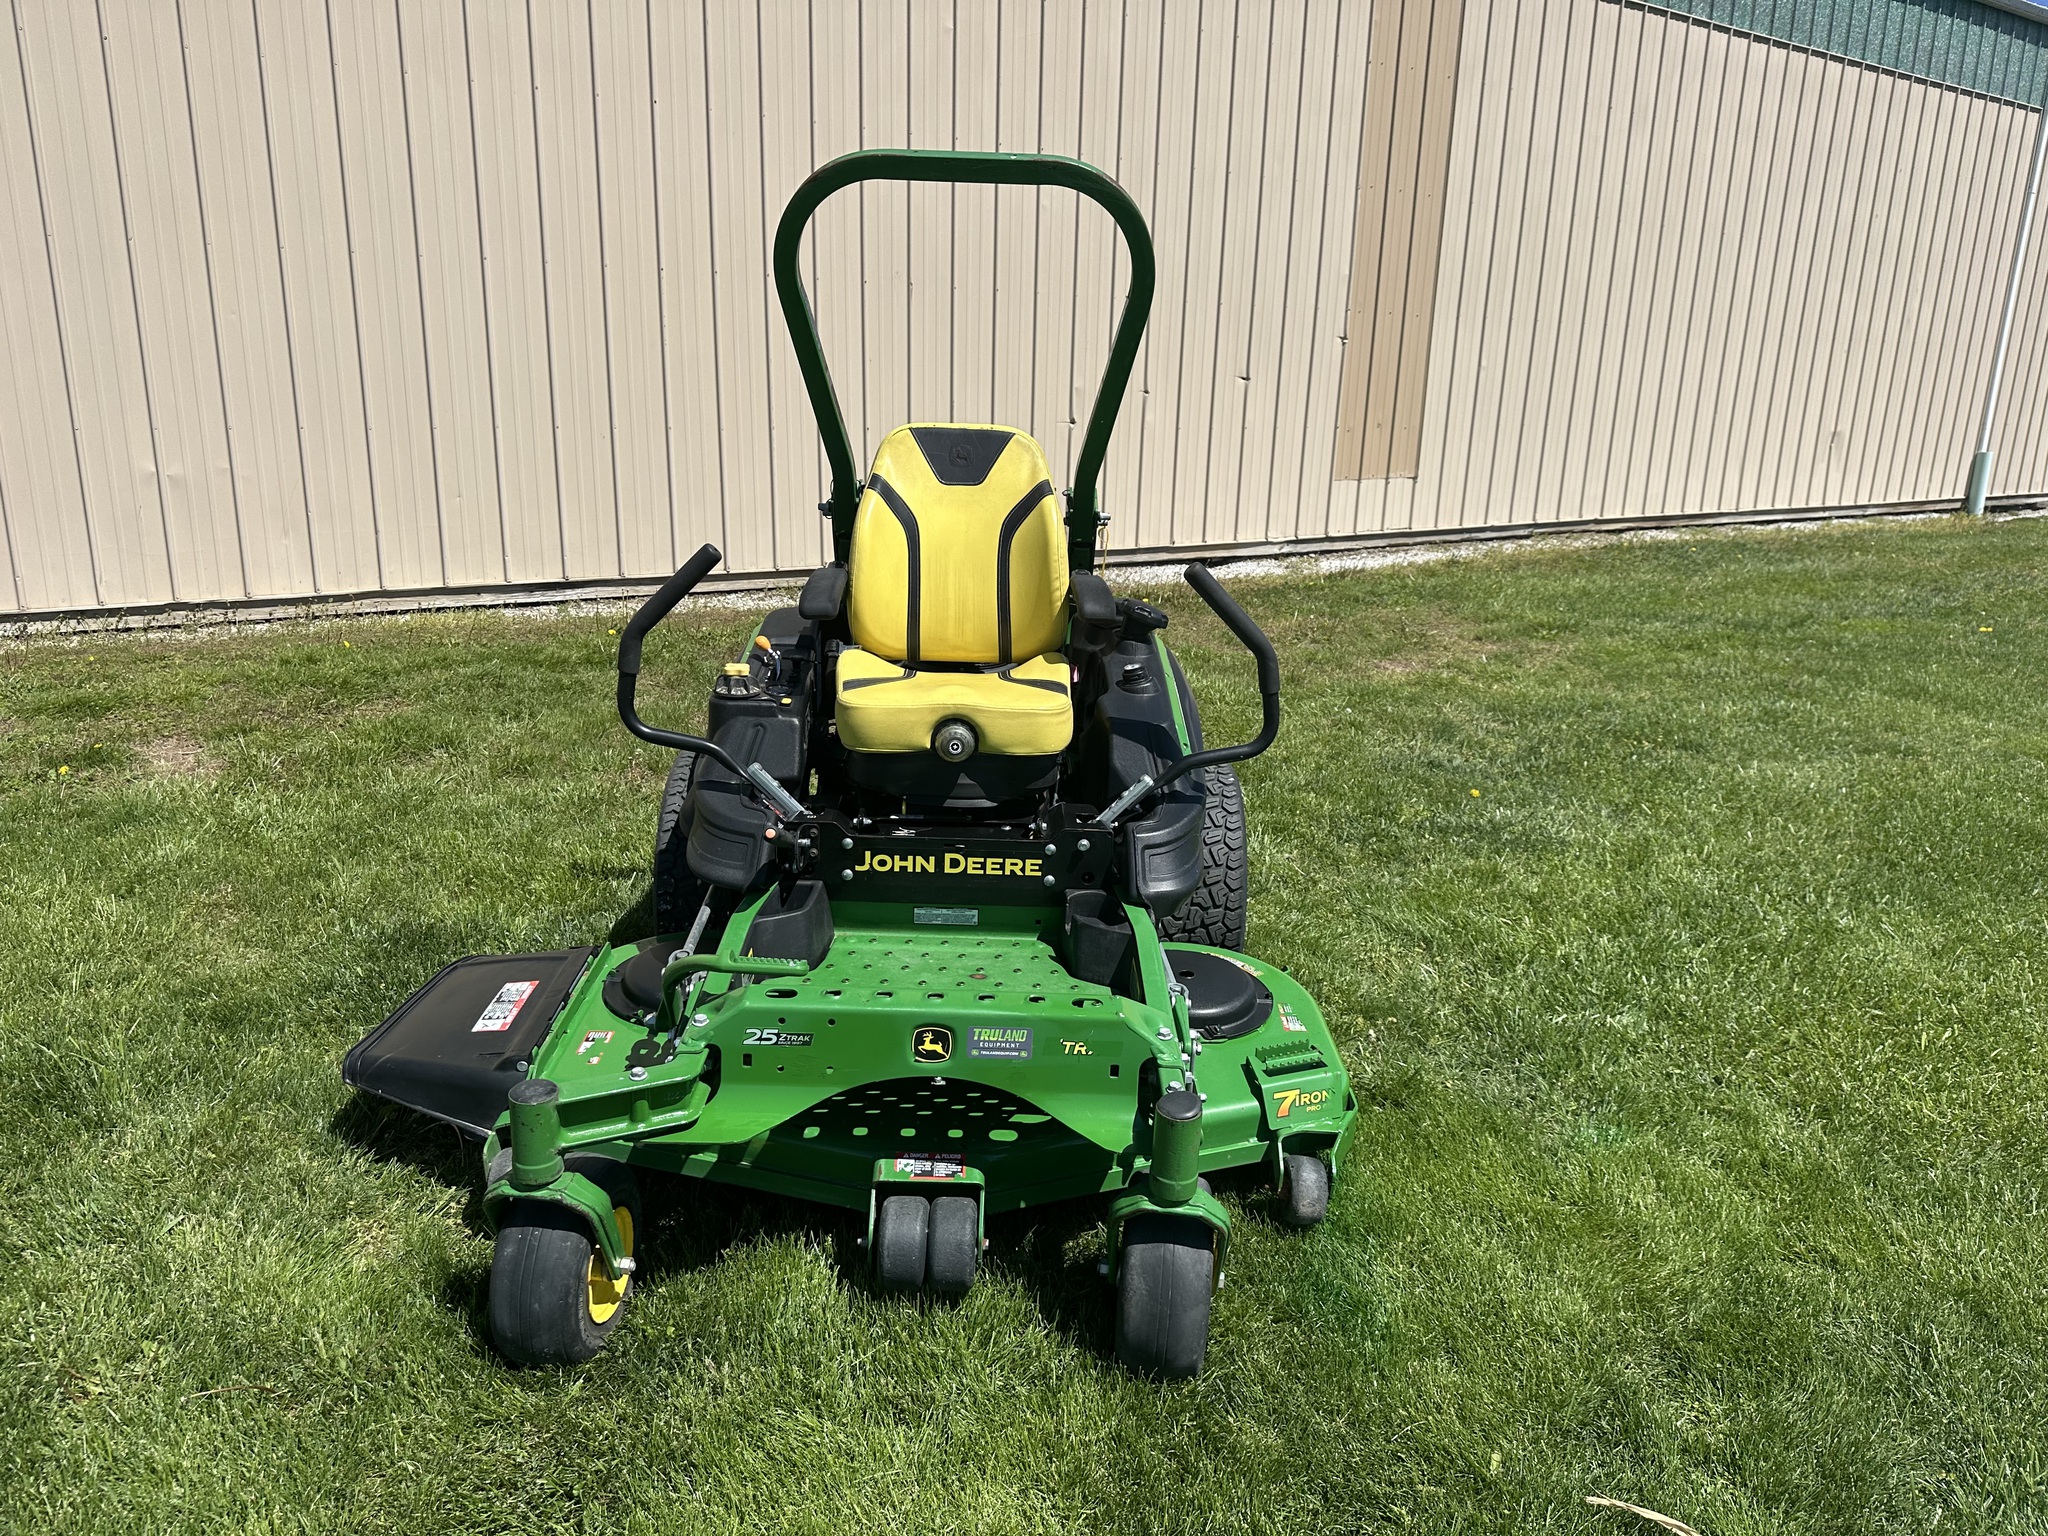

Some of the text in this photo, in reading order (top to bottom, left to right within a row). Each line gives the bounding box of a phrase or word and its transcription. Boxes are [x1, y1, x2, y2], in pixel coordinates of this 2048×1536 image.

[855, 851, 1042, 876] JOHN DEERE
[743, 1028, 810, 1045] 25 ZTRAK
[973, 1028, 1028, 1042] TRULAND
